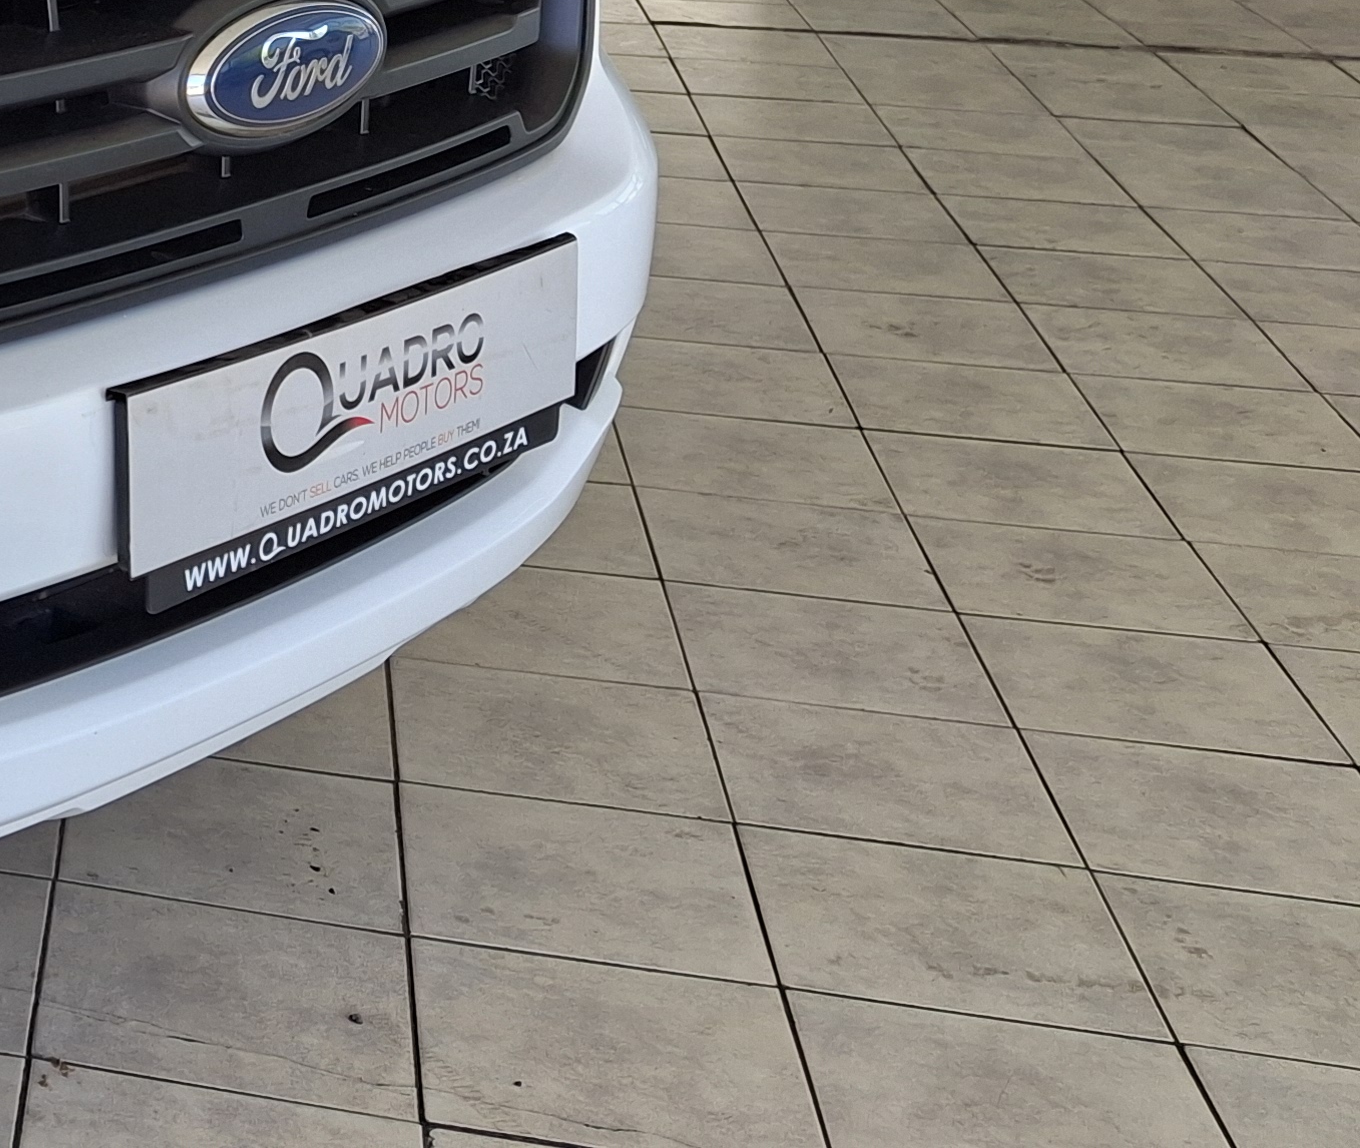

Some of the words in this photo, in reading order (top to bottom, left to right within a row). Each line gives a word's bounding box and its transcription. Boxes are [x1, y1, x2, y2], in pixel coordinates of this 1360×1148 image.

[250, 22, 355, 109] Ford
[260, 312, 486, 473] QUADRO
[379, 363, 485, 434] MOTORS
[184, 426, 530, 592] WWW.QUADROMOTORS.CO.ZA
[259, 503, 276, 518] WE
[278, 488, 308, 511] DON'T
[309, 483, 332, 499] SELL
[361, 463, 379, 478] WE
[379, 452, 402, 470] HELP
[403, 436, 436, 461] PEOPLE
[437, 428, 455, 446] BUY
